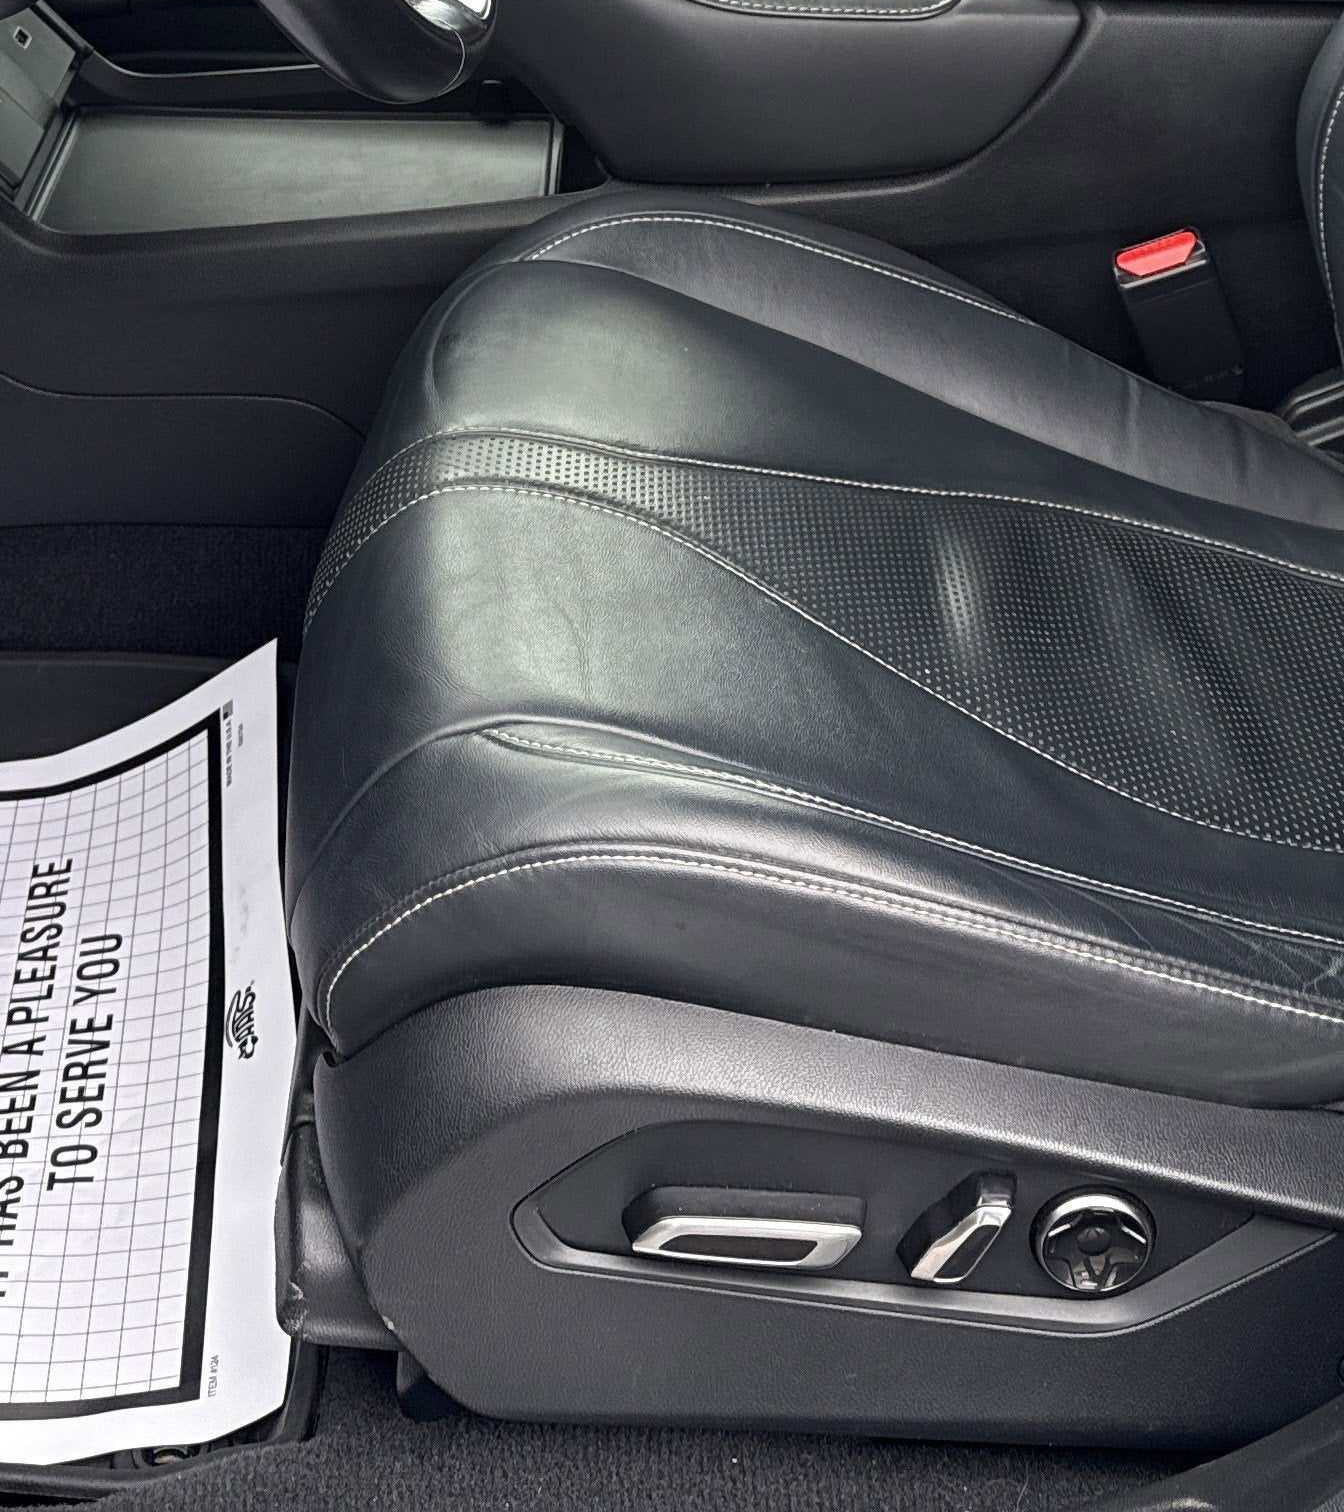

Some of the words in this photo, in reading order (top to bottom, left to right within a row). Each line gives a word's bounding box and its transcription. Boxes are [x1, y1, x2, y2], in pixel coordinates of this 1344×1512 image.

[6, 857, 74, 1028] PLEASURE
[73, 932, 123, 1006] YOU
[0, 1034, 47, 1057] A
[56, 1013, 114, 1129] SERVE
[47, 1142, 99, 1191] TO
[207, 1375, 217, 1398] ITEM
